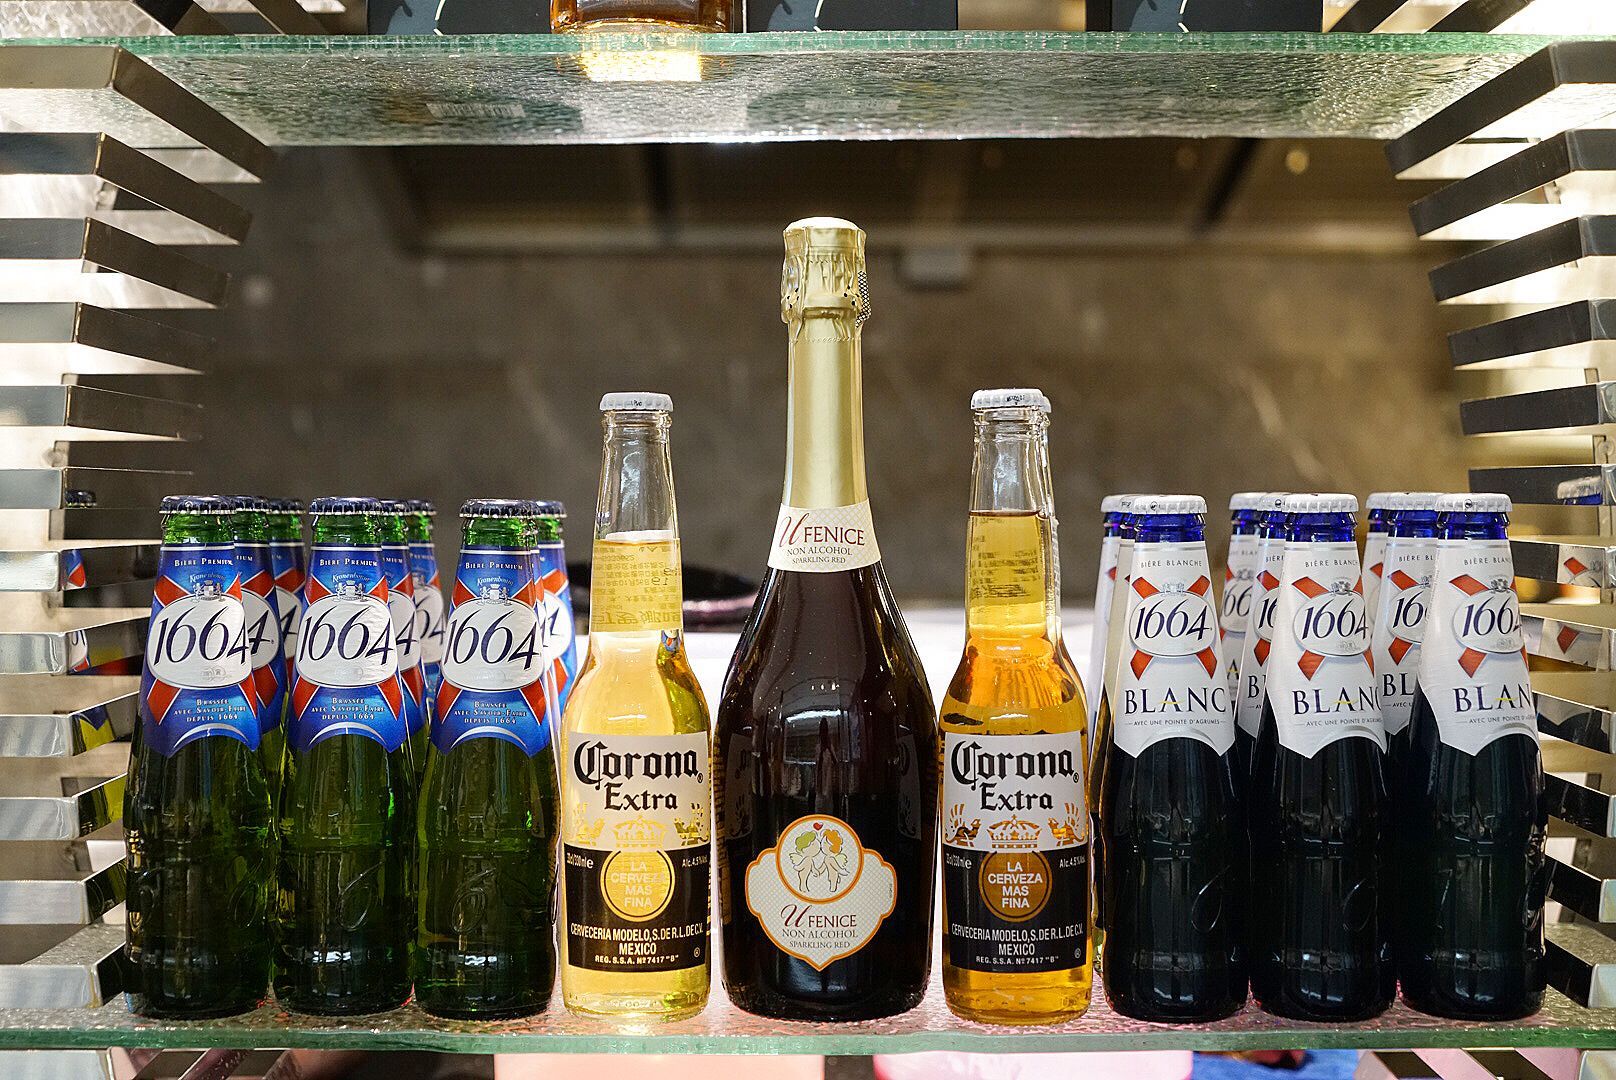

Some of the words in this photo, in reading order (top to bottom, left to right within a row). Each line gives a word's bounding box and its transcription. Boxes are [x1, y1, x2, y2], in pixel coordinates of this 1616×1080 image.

[786, 546, 806, 556] NON
[807, 546, 853, 556] ALCOHOL
[792, 556, 830, 565] SPARKLING
[831, 556, 846, 564] RED
[1166, 559, 1202, 567] BLANCHE
[1134, 598, 1209, 641] 1664
[1301, 598, 1369, 640] 1664
[153, 604, 250, 666] 1664
[298, 605, 394, 666] 1664
[443, 608, 540, 670] 1664
[1124, 686, 1226, 715] BLANC
[1452, 683, 1532, 713] BLAN
[352, 712, 375, 720] 1664
[495, 716, 517, 724] 1664
[1469, 717, 1485, 725] AVEC
[1306, 720, 1324, 728] AVEC
[574, 740, 699, 791] Corona
[951, 740, 1075, 791] Corona
[604, 782, 679, 812] Extra
[979, 782, 1054, 812] Extra
[630, 861, 647, 872] LA
[1007, 861, 1024, 872] LA
[610, 872, 666, 884] CERVEZA
[987, 873, 1043, 885] CERVEZA
[625, 885, 653, 896] MAS
[1002, 886, 1030, 897] MAS
[624, 897, 653, 908] FINA
[1001, 898, 1031, 909] FINA
[570, 922, 612, 941] CERVECERIA
[782, 928, 806, 938] NON
[808, 928, 859, 939] ALCOHOL
[951, 922, 991, 941] CERVECERIA
[618, 942, 657, 956] MEXICO
[789, 940, 833, 949] SPARKLING
[833, 941, 851, 949] RED
[998, 943, 1036, 956] MEXICO
[594, 954, 612, 964] REG.
[975, 955, 992, 964] REG.
